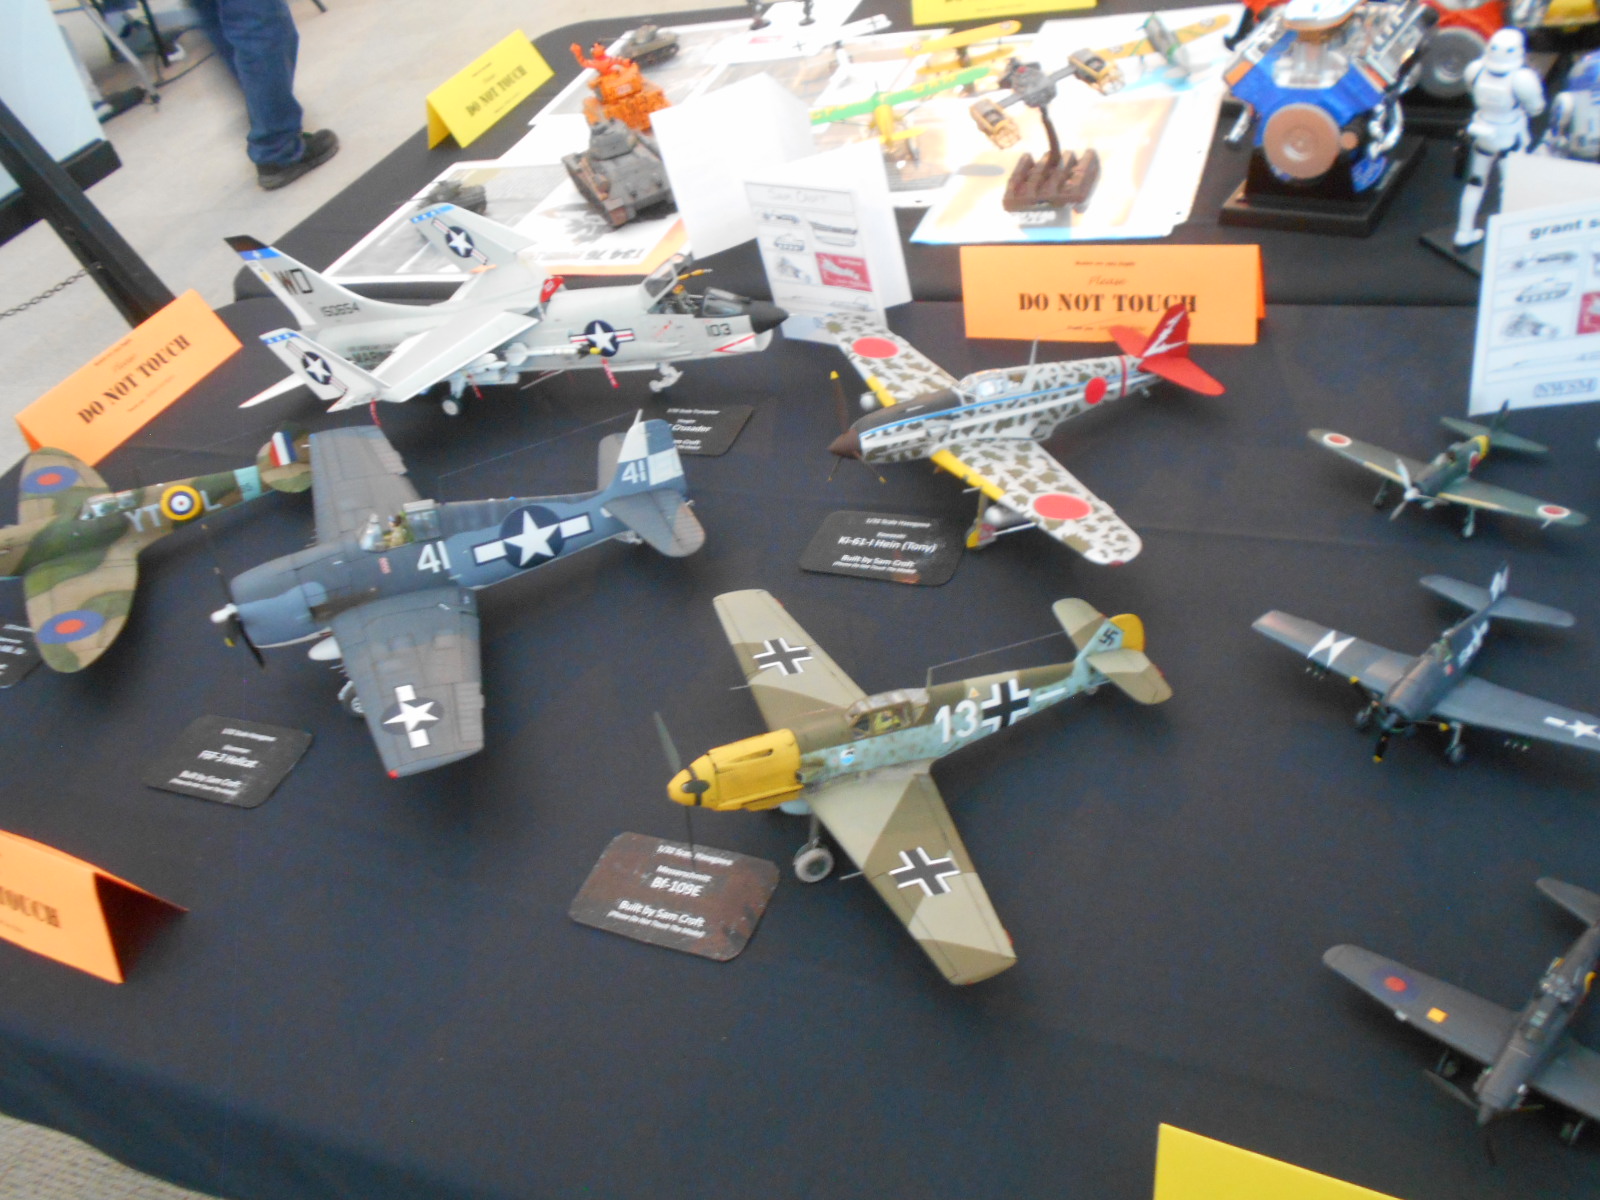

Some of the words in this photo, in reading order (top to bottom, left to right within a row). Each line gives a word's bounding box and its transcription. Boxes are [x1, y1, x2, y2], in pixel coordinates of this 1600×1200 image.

[465, 101, 481, 117] DO
[479, 87, 499, 104] NOT
[497, 64, 528, 91] TOUCH
[1529, 219, 1583, 240] grant
[1018, 292, 1049, 311] DO
[1058, 293, 1102, 312] NOT
[1112, 293, 1198, 313] TOUCH
[705, 323, 732, 337] 103
[78, 401, 104, 424] DO
[103, 374, 138, 404] NOT
[137, 335, 191, 377] TOUCH
[621, 459, 647, 485] 41
[124, 503, 161, 532] YT
[201, 490, 223, 511] L
[416, 540, 453, 573] 41
[935, 699, 978, 743] 13
[651, 876, 703, 897] Bf-109E
[0, 886, 60, 928] OUCH
[618, 900, 643, 914] Built
[641, 903, 656, 918] by
[654, 908, 679, 921] Sam
